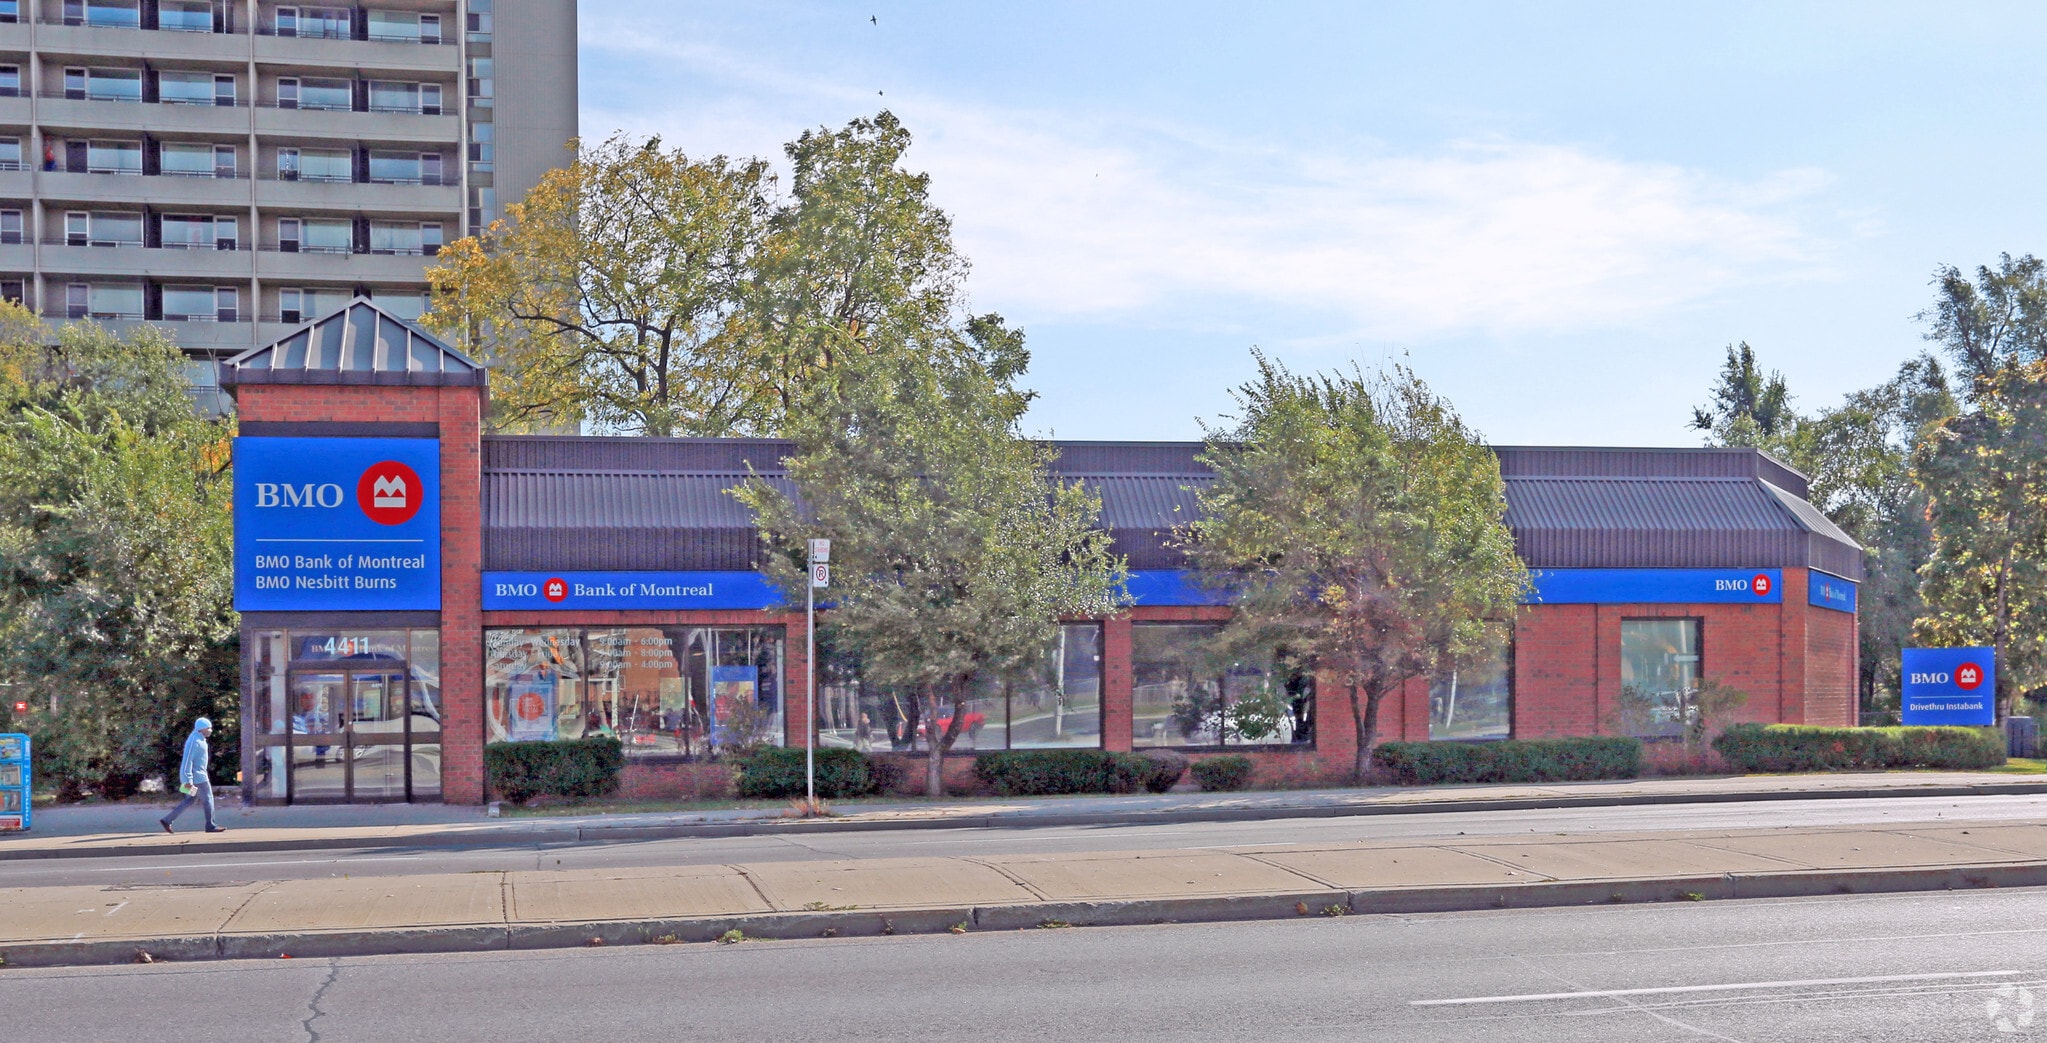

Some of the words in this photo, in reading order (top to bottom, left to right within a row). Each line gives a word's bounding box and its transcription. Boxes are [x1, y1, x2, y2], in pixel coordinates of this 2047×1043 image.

[255, 483, 344, 508] BMO
[255, 556, 290, 569] BMO
[295, 554, 333, 569] Bank
[338, 554, 353, 569] of
[358, 554, 425, 569] Montreal
[255, 576, 290, 589] BMO
[295, 575, 350, 589] Nesbitt
[355, 576, 397, 589] Burns
[1715, 579, 1748, 591] BMO
[495, 583, 537, 597] BMO
[574, 583, 616, 597] Bank
[620, 583, 636, 597] of
[639, 583, 714, 597] Montreal
[325, 637, 369, 655] 4411
[640, 637, 673, 647] 6:00pm
[640, 649, 673, 658] 8:00pm
[640, 660, 673, 670] 4:00pm
[1910, 672, 1949, 685] BMO
[1910, 702, 1945, 711] Drivethru
[1946, 701, 1984, 710] Instabank
